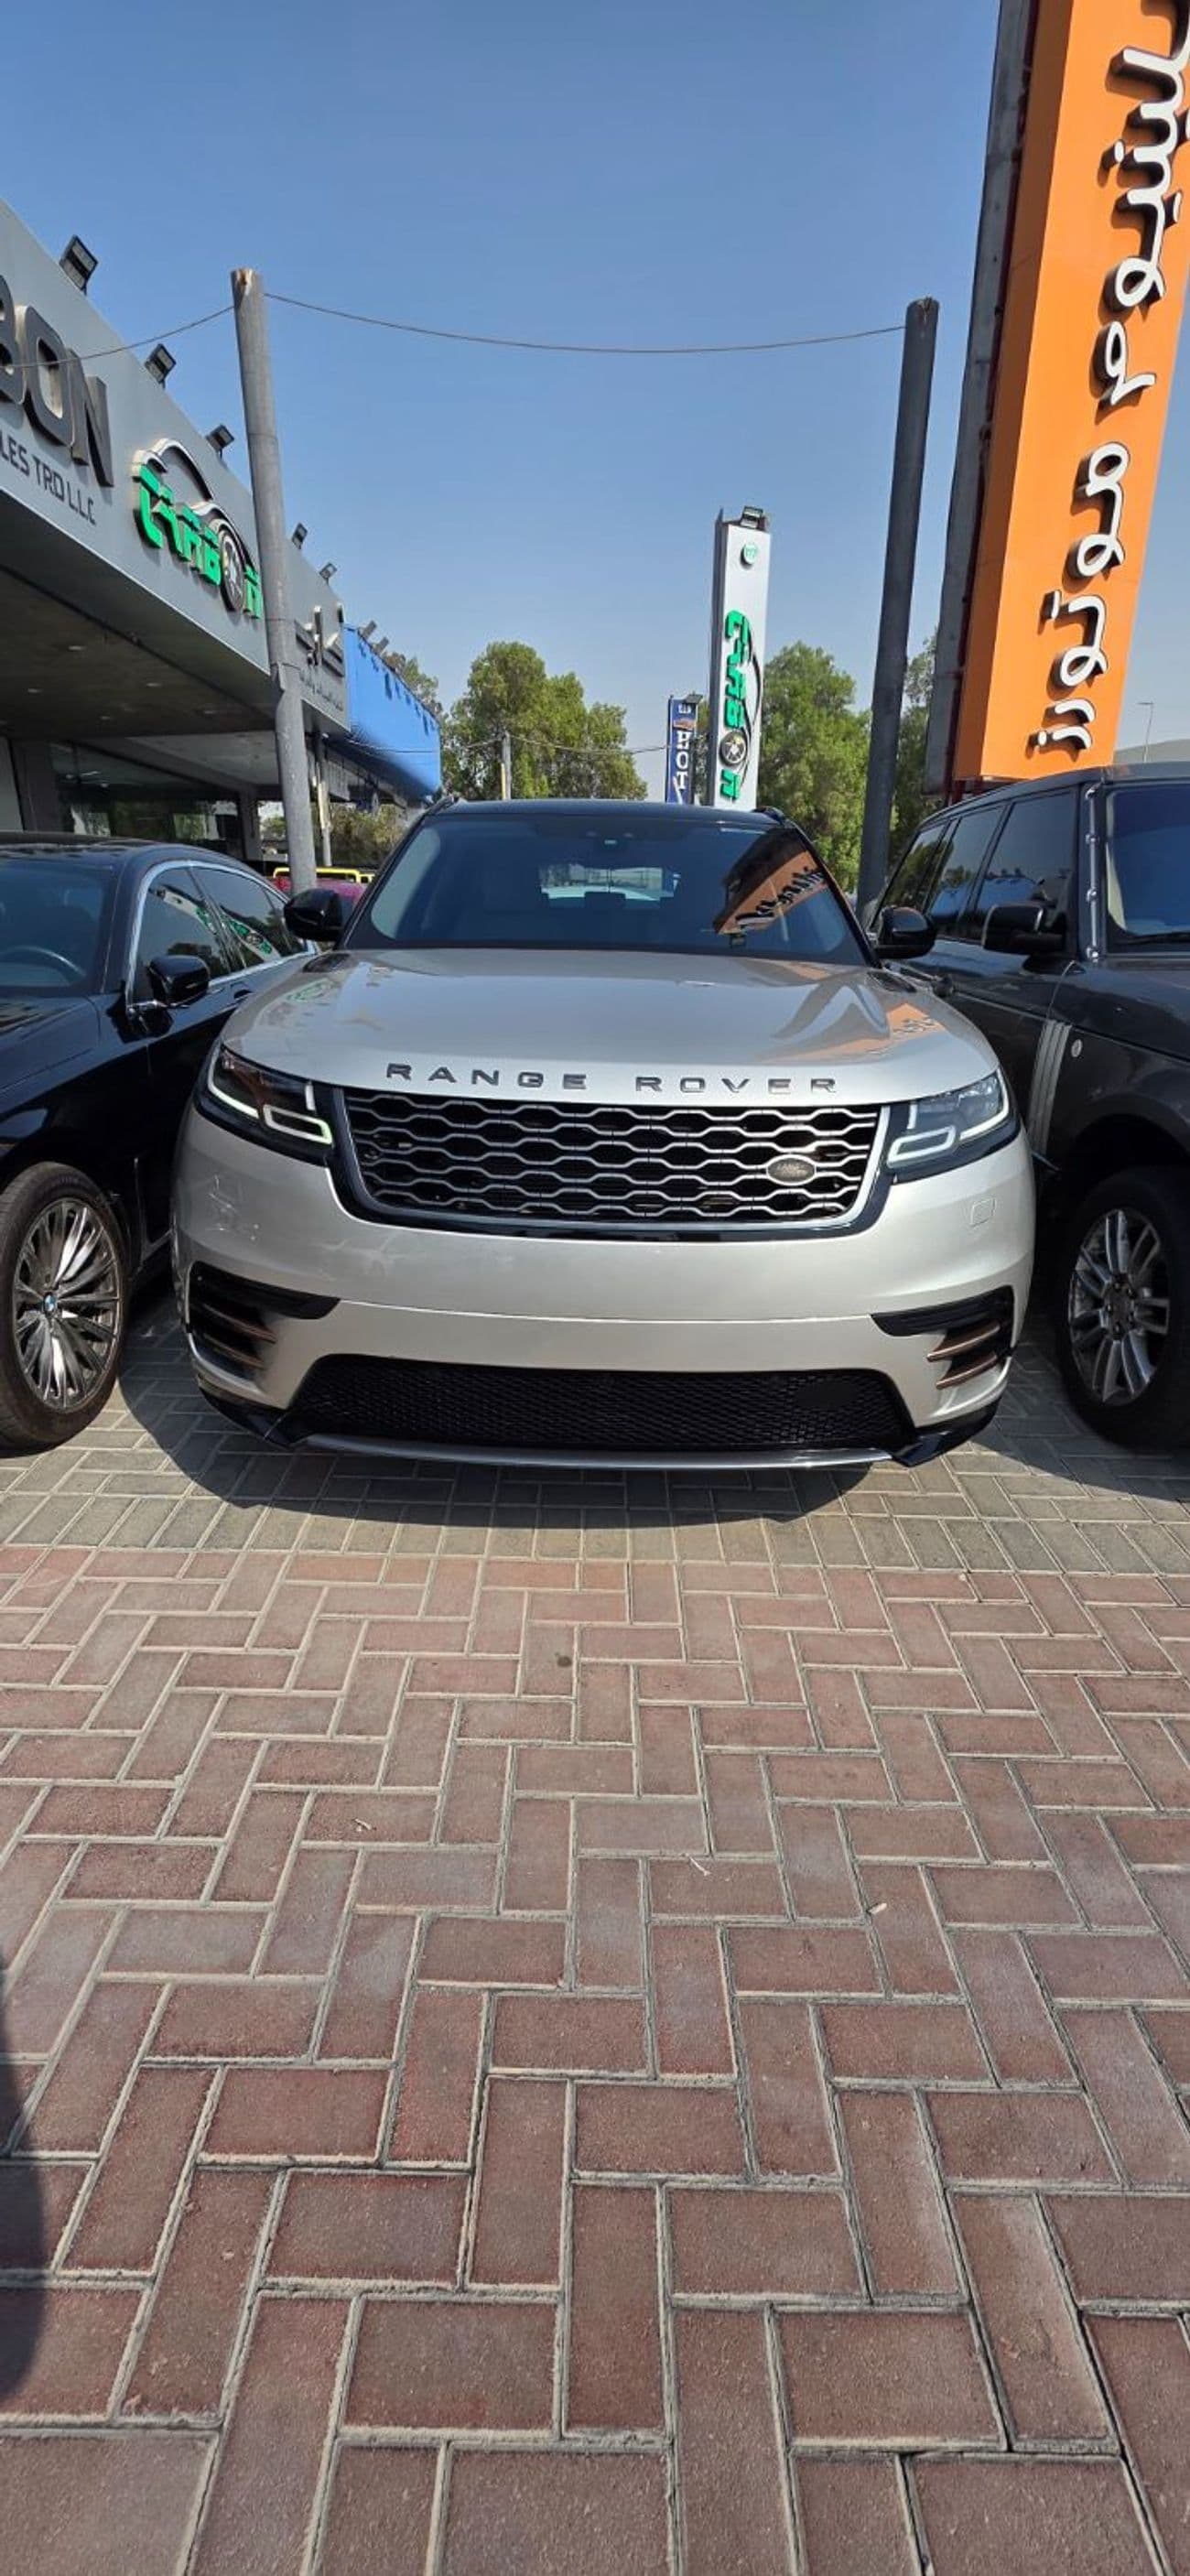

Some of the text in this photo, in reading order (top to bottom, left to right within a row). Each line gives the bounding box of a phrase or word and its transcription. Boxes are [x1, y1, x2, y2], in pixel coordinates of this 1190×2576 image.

[32, 456, 65, 503] TRD
[66, 481, 96, 525] LLC
[1037, 441, 1130, 750] موتورز
[386, 1063, 837, 1095] RANGE ROVER
